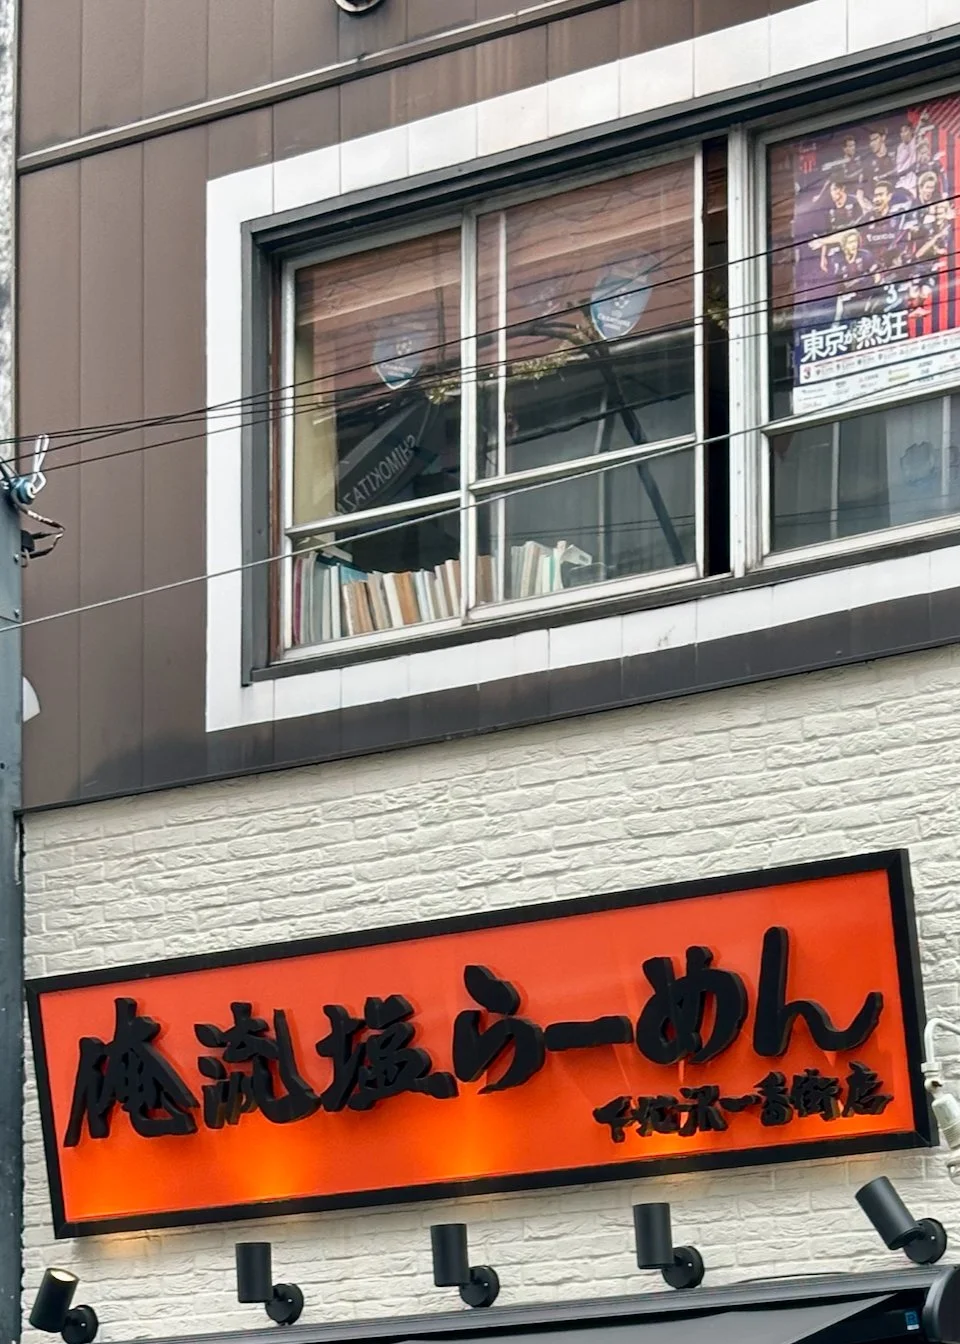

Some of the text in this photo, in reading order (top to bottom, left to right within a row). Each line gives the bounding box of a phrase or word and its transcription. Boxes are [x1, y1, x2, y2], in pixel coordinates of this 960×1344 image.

[801, 311, 908, 364] 東京が熱狂
[64, 926, 884, 1148] 俺流塩らーめん
